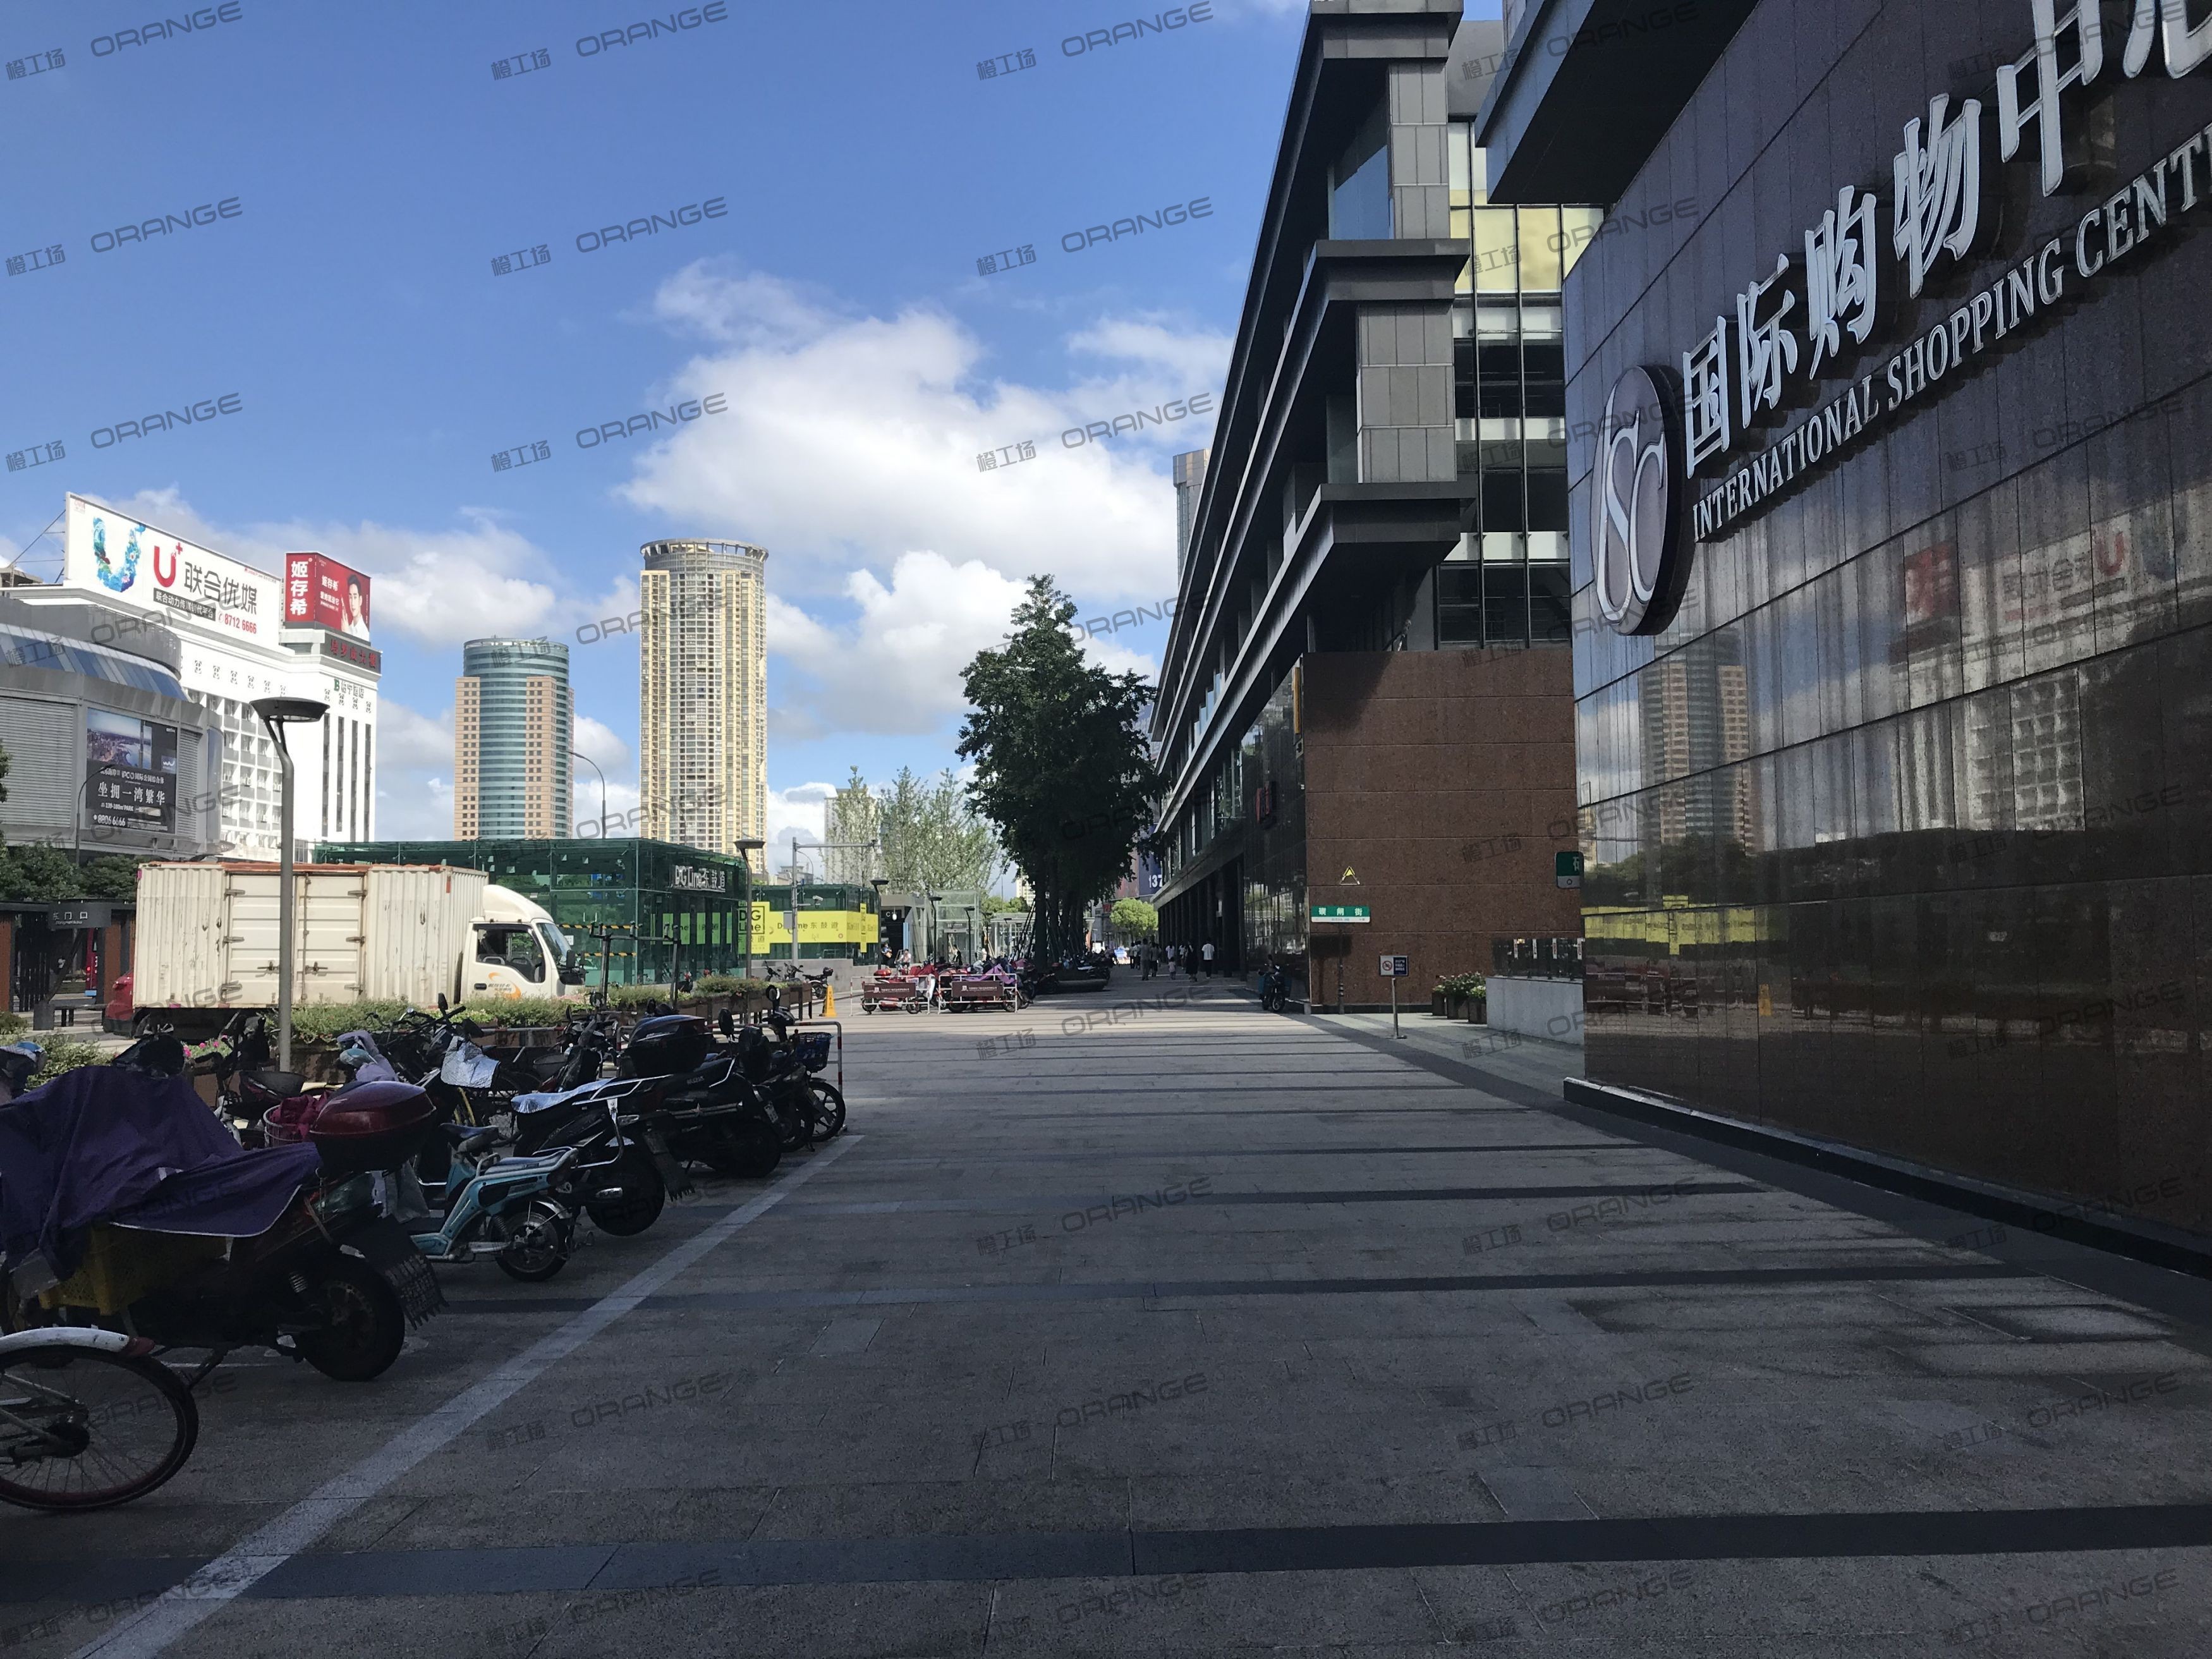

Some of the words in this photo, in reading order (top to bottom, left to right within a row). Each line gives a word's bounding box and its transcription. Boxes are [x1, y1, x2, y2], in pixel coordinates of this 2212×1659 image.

[1694, 374, 1880, 544] INTERNATIONAL
[1888, 238, 2064, 412] SHOPPING
[2075, 122, 2212, 278] CENT
[183, 561, 257, 615] 联合优媒
[290, 561, 308, 616] 姬存希
[224, 613, 240, 628] 8712
[241, 620, 257, 635] 6666
[97, 781, 165, 806] 坐拥一湾繁华
[811, 921, 839, 930] 东鼓道
